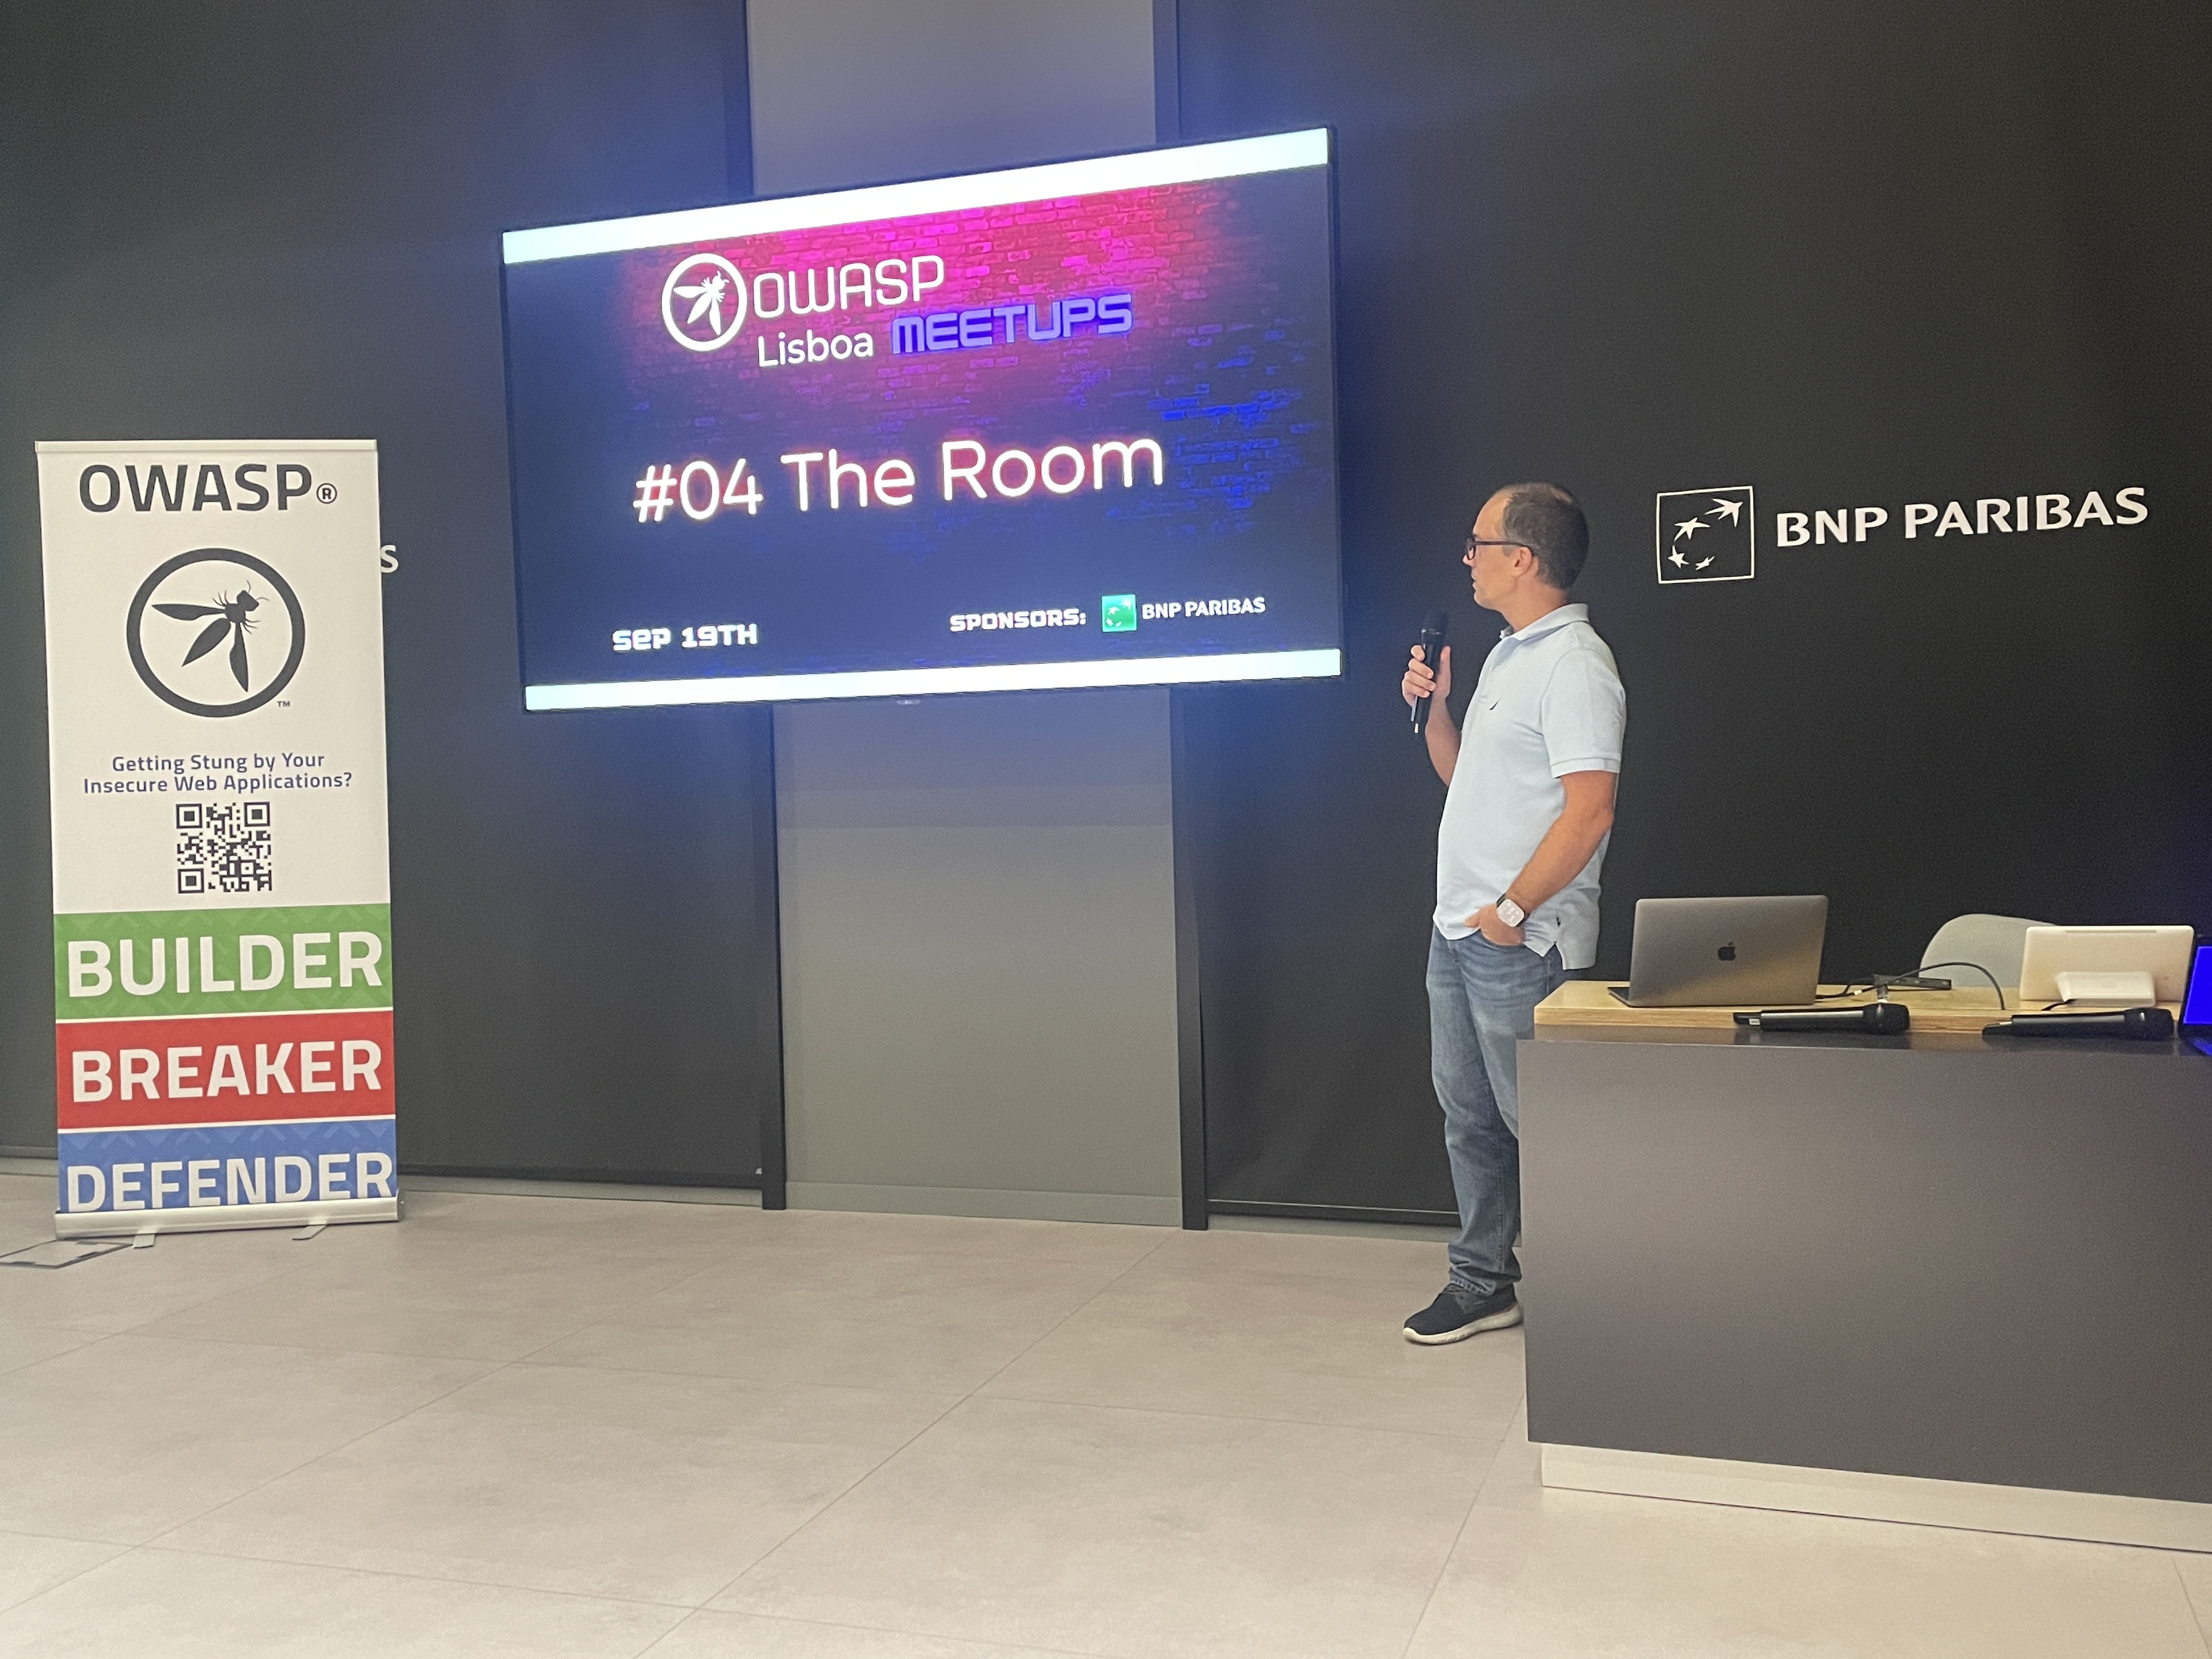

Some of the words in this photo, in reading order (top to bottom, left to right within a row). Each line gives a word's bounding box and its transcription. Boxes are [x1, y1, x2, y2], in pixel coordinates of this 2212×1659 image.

[753, 255, 945, 318] OWASP
[758, 329, 873, 367] Lisboa
[891, 292, 1134, 354] MEETUPS
[633, 458, 764, 523] #04
[780, 448, 916, 512] The
[941, 438, 1164, 501] Room
[1776, 506, 1889, 548] BNP
[1904, 486, 2149, 540] PARIBAS
[681, 623, 758, 648] 19TH
[950, 608, 1086, 633] SPONSORS:
[1142, 602, 1182, 619] BNP
[1185, 597, 1266, 617] PARIBAS
[84, 777, 168, 794] Insecure
[174, 775, 217, 791] Web
[224, 772, 352, 794] Applications?
[112, 755, 185, 774] Getting
[190, 754, 247, 772] Stung
[253, 753, 275, 771] by
[281, 752, 325, 768] Your
[67, 931, 382, 997] BUILDER
[72, 1040, 382, 1103] BREAKER
[67, 1152, 393, 1213] DEFENDER
